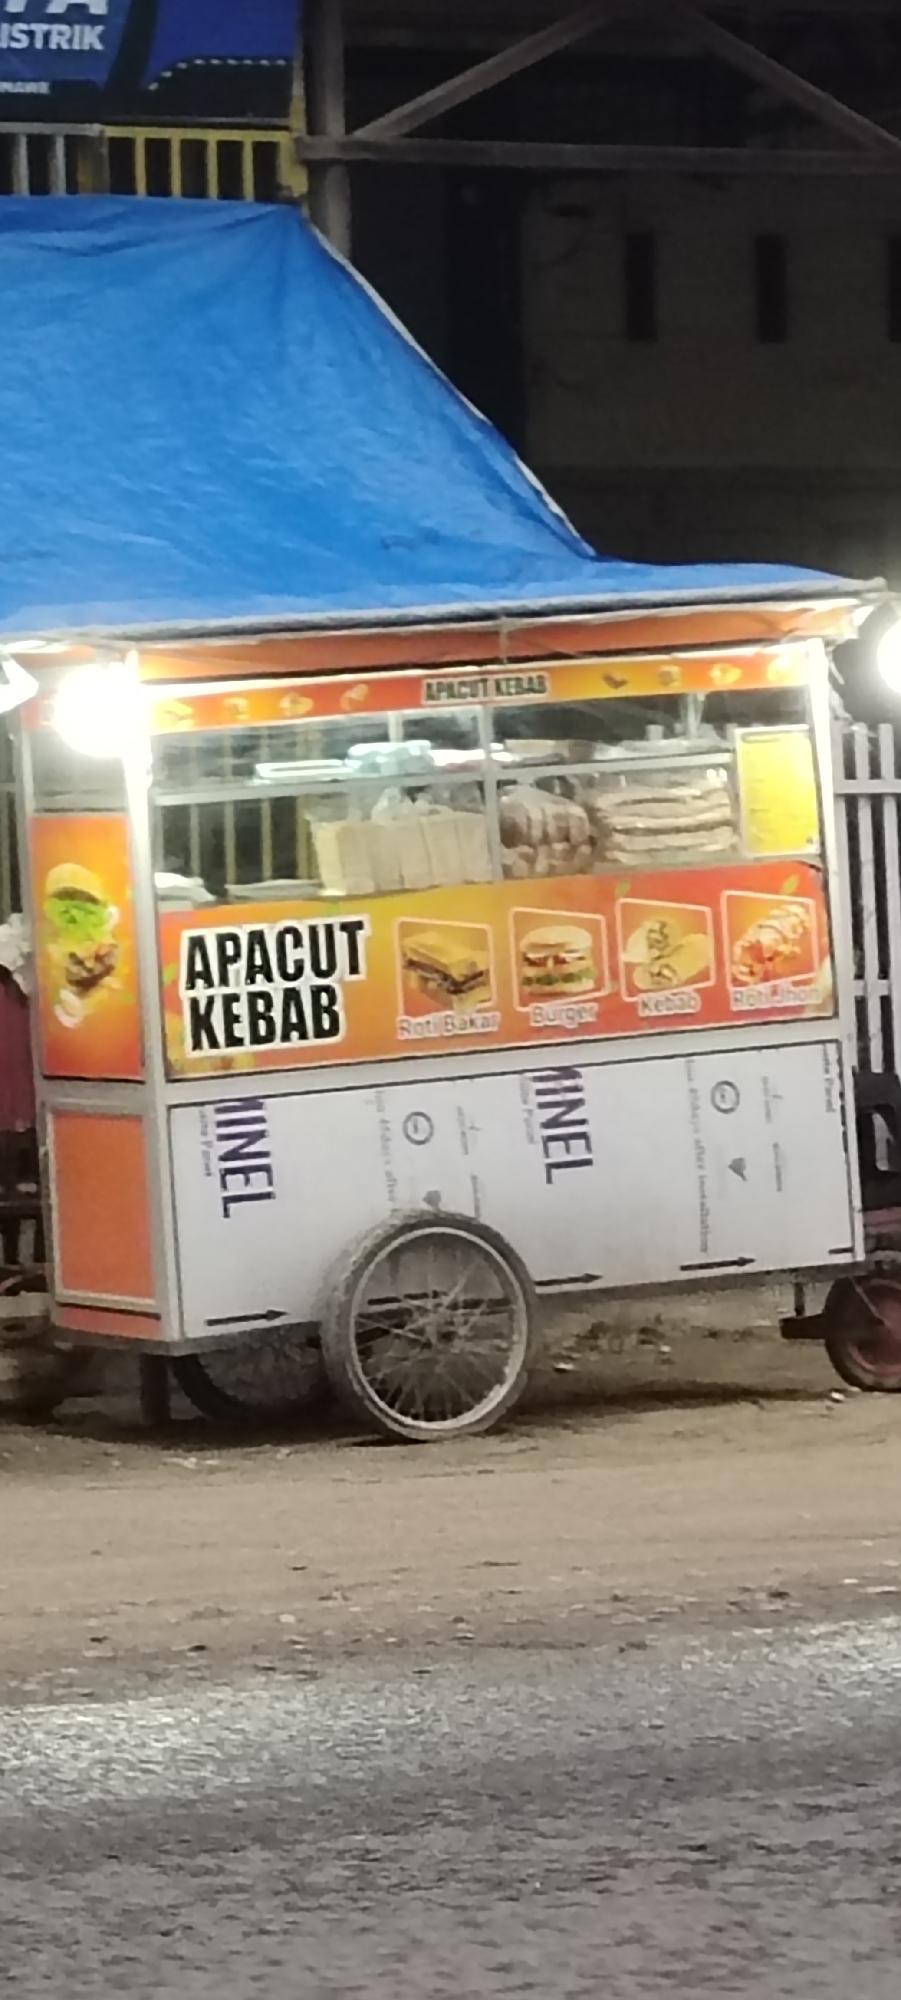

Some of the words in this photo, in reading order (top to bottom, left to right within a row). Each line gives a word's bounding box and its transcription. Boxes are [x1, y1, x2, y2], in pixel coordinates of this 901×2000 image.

[425, 678, 489, 702] APACUT
[493, 675, 547, 697] KEBAB
[184, 918, 366, 991] APACUT
[640, 990, 698, 1014] Kebab
[732, 986, 769, 1008] Roti
[188, 983, 341, 1052] KEBAB
[398, 1016, 438, 1038] Roti
[443, 1012, 499, 1034] Bakar
[532, 1004, 597, 1027] Burger
